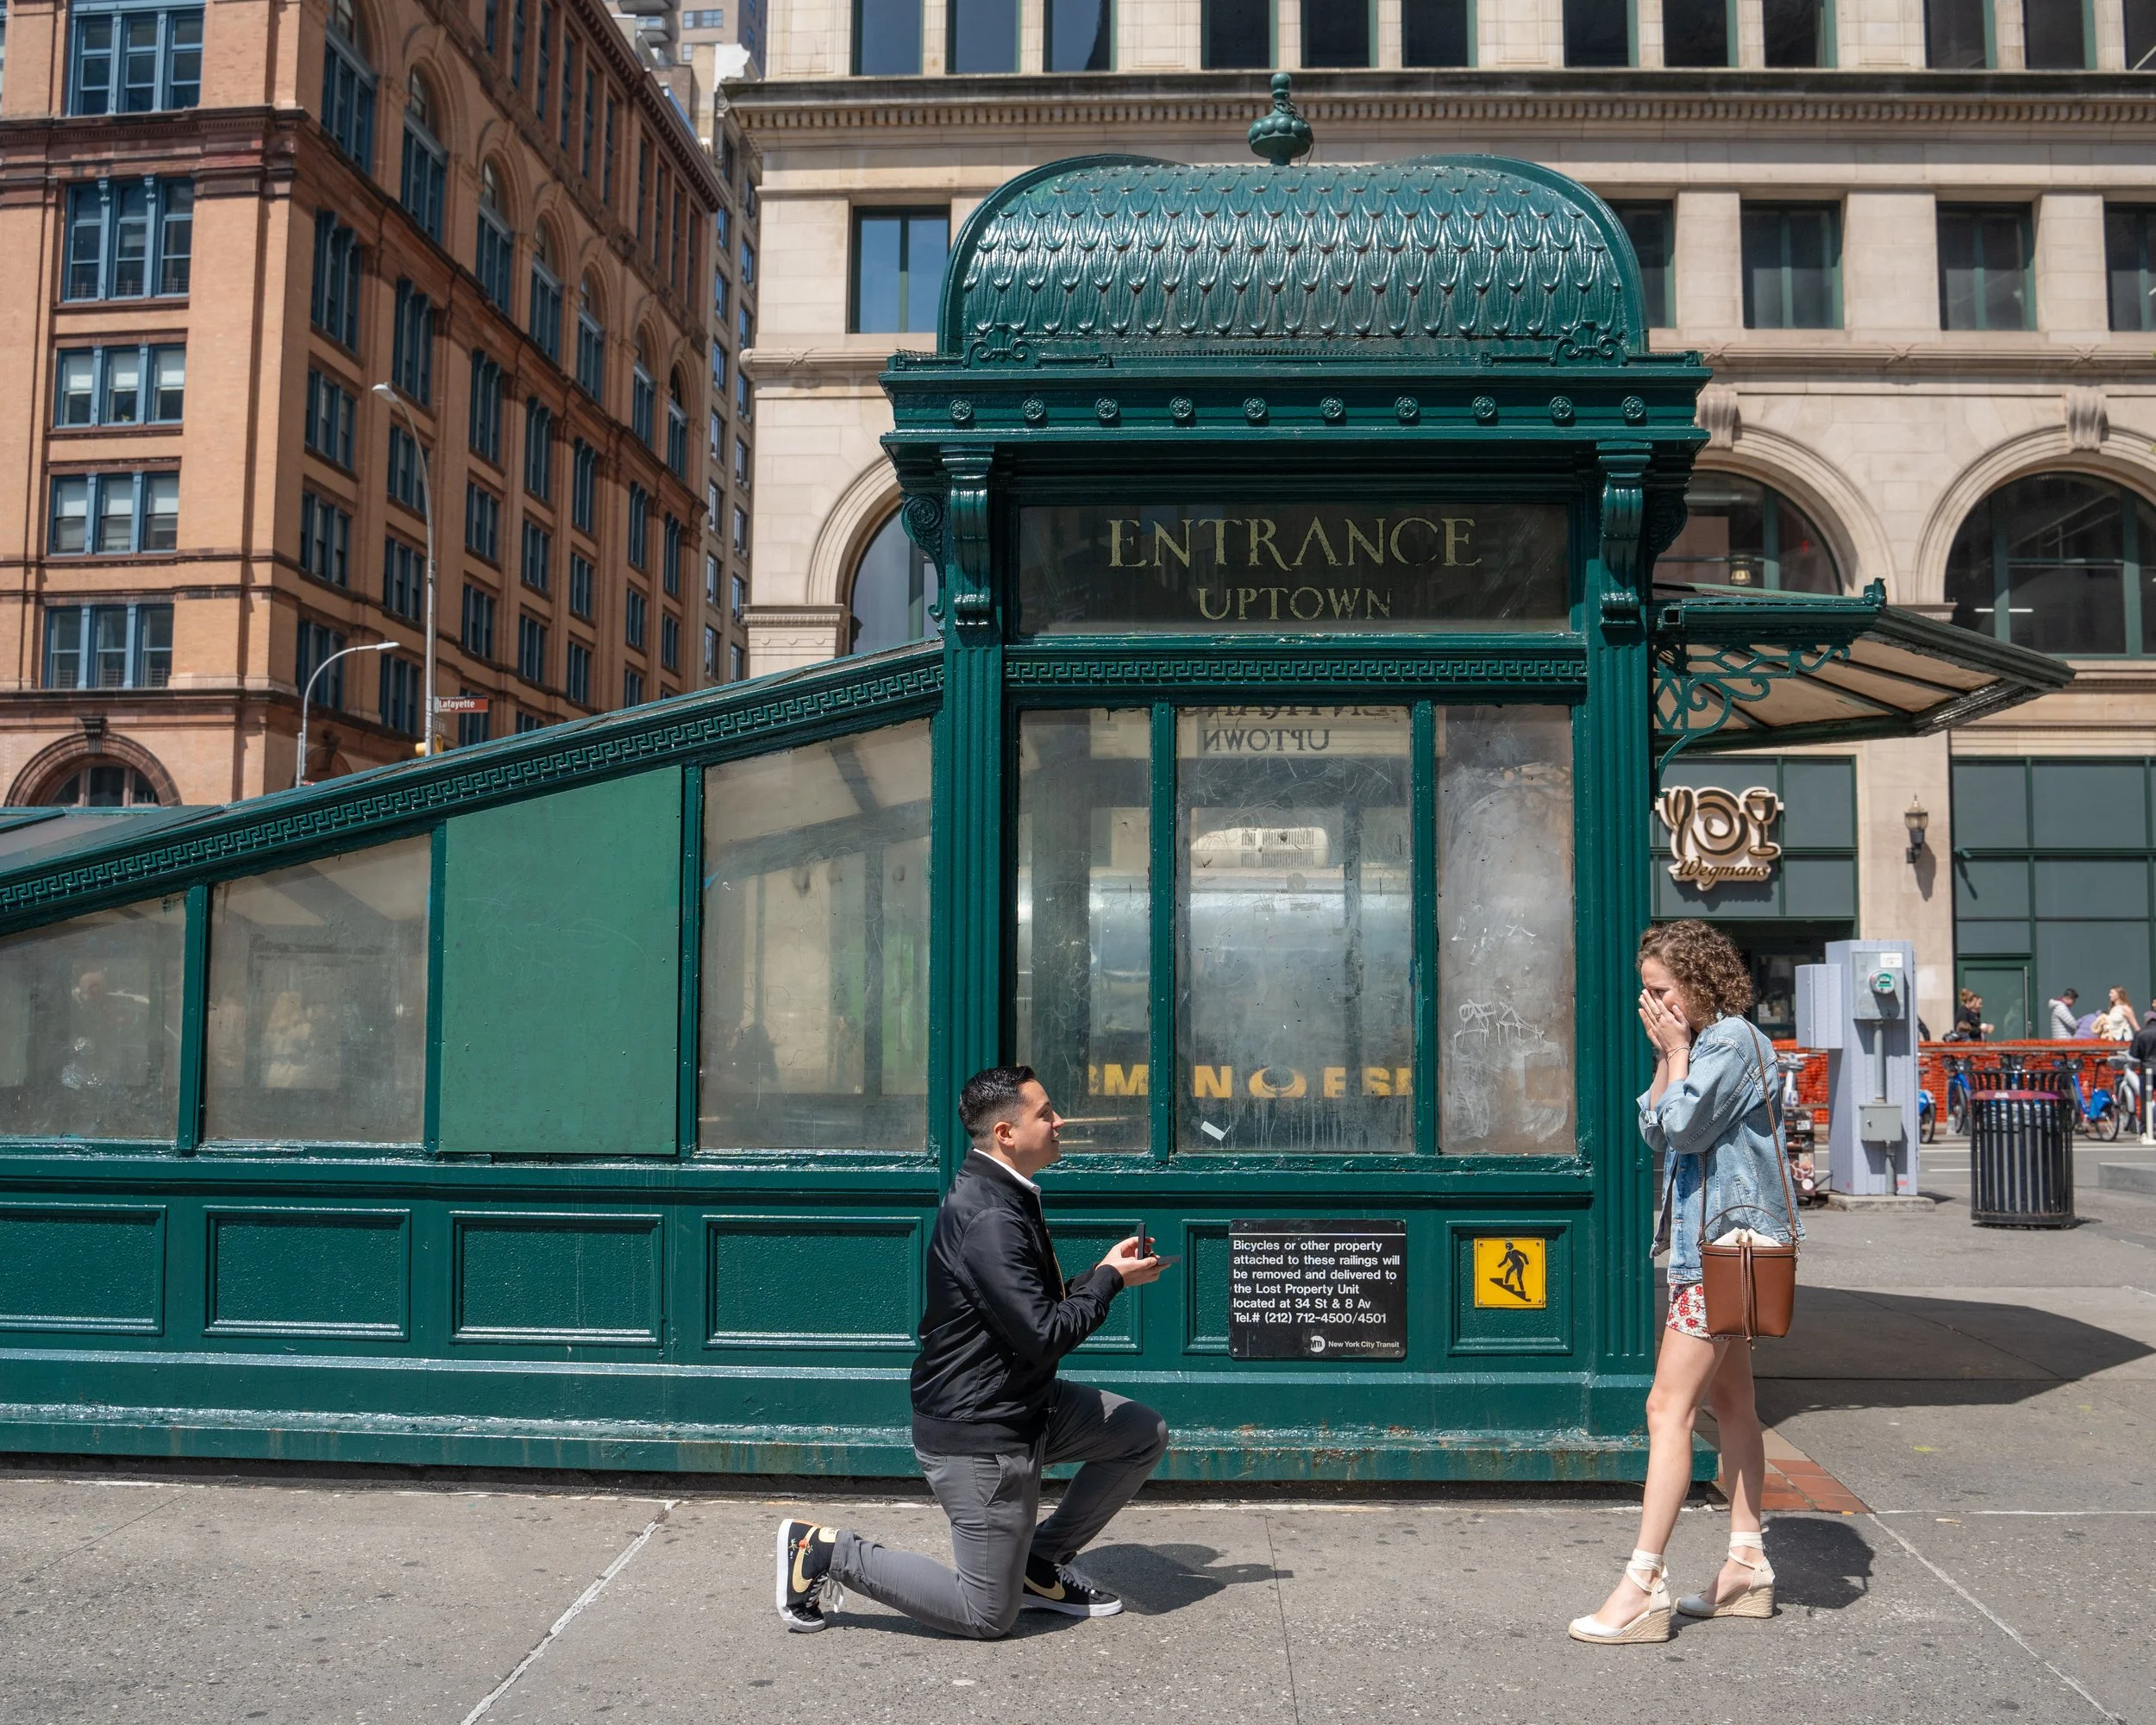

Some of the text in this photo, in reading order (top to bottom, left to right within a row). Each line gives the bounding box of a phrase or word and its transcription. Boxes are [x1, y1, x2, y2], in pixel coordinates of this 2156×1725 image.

[1108, 516, 1482, 571] ENTRANCE
[1196, 586, 1393, 622] UPTOWN
[440, 699, 475, 710] Lafayette
[1674, 856, 1767, 886] Wegmans
[1233, 1240, 1280, 1251] Bicycles
[1300, 1240, 1330, 1250] other
[1334, 1241, 1382, 1252] property
[1234, 1255, 1400, 1266] attached to these railings will
[1233, 1270, 1396, 1279] be removed and delivered to
[1234, 1283, 1359, 1295] the Lost Property Unit
[1233, 1298, 1371, 1308] located at 34 St & 8 Av
[1234, 1312, 1386, 1324] Tel.# (212) 712-4500/4501
